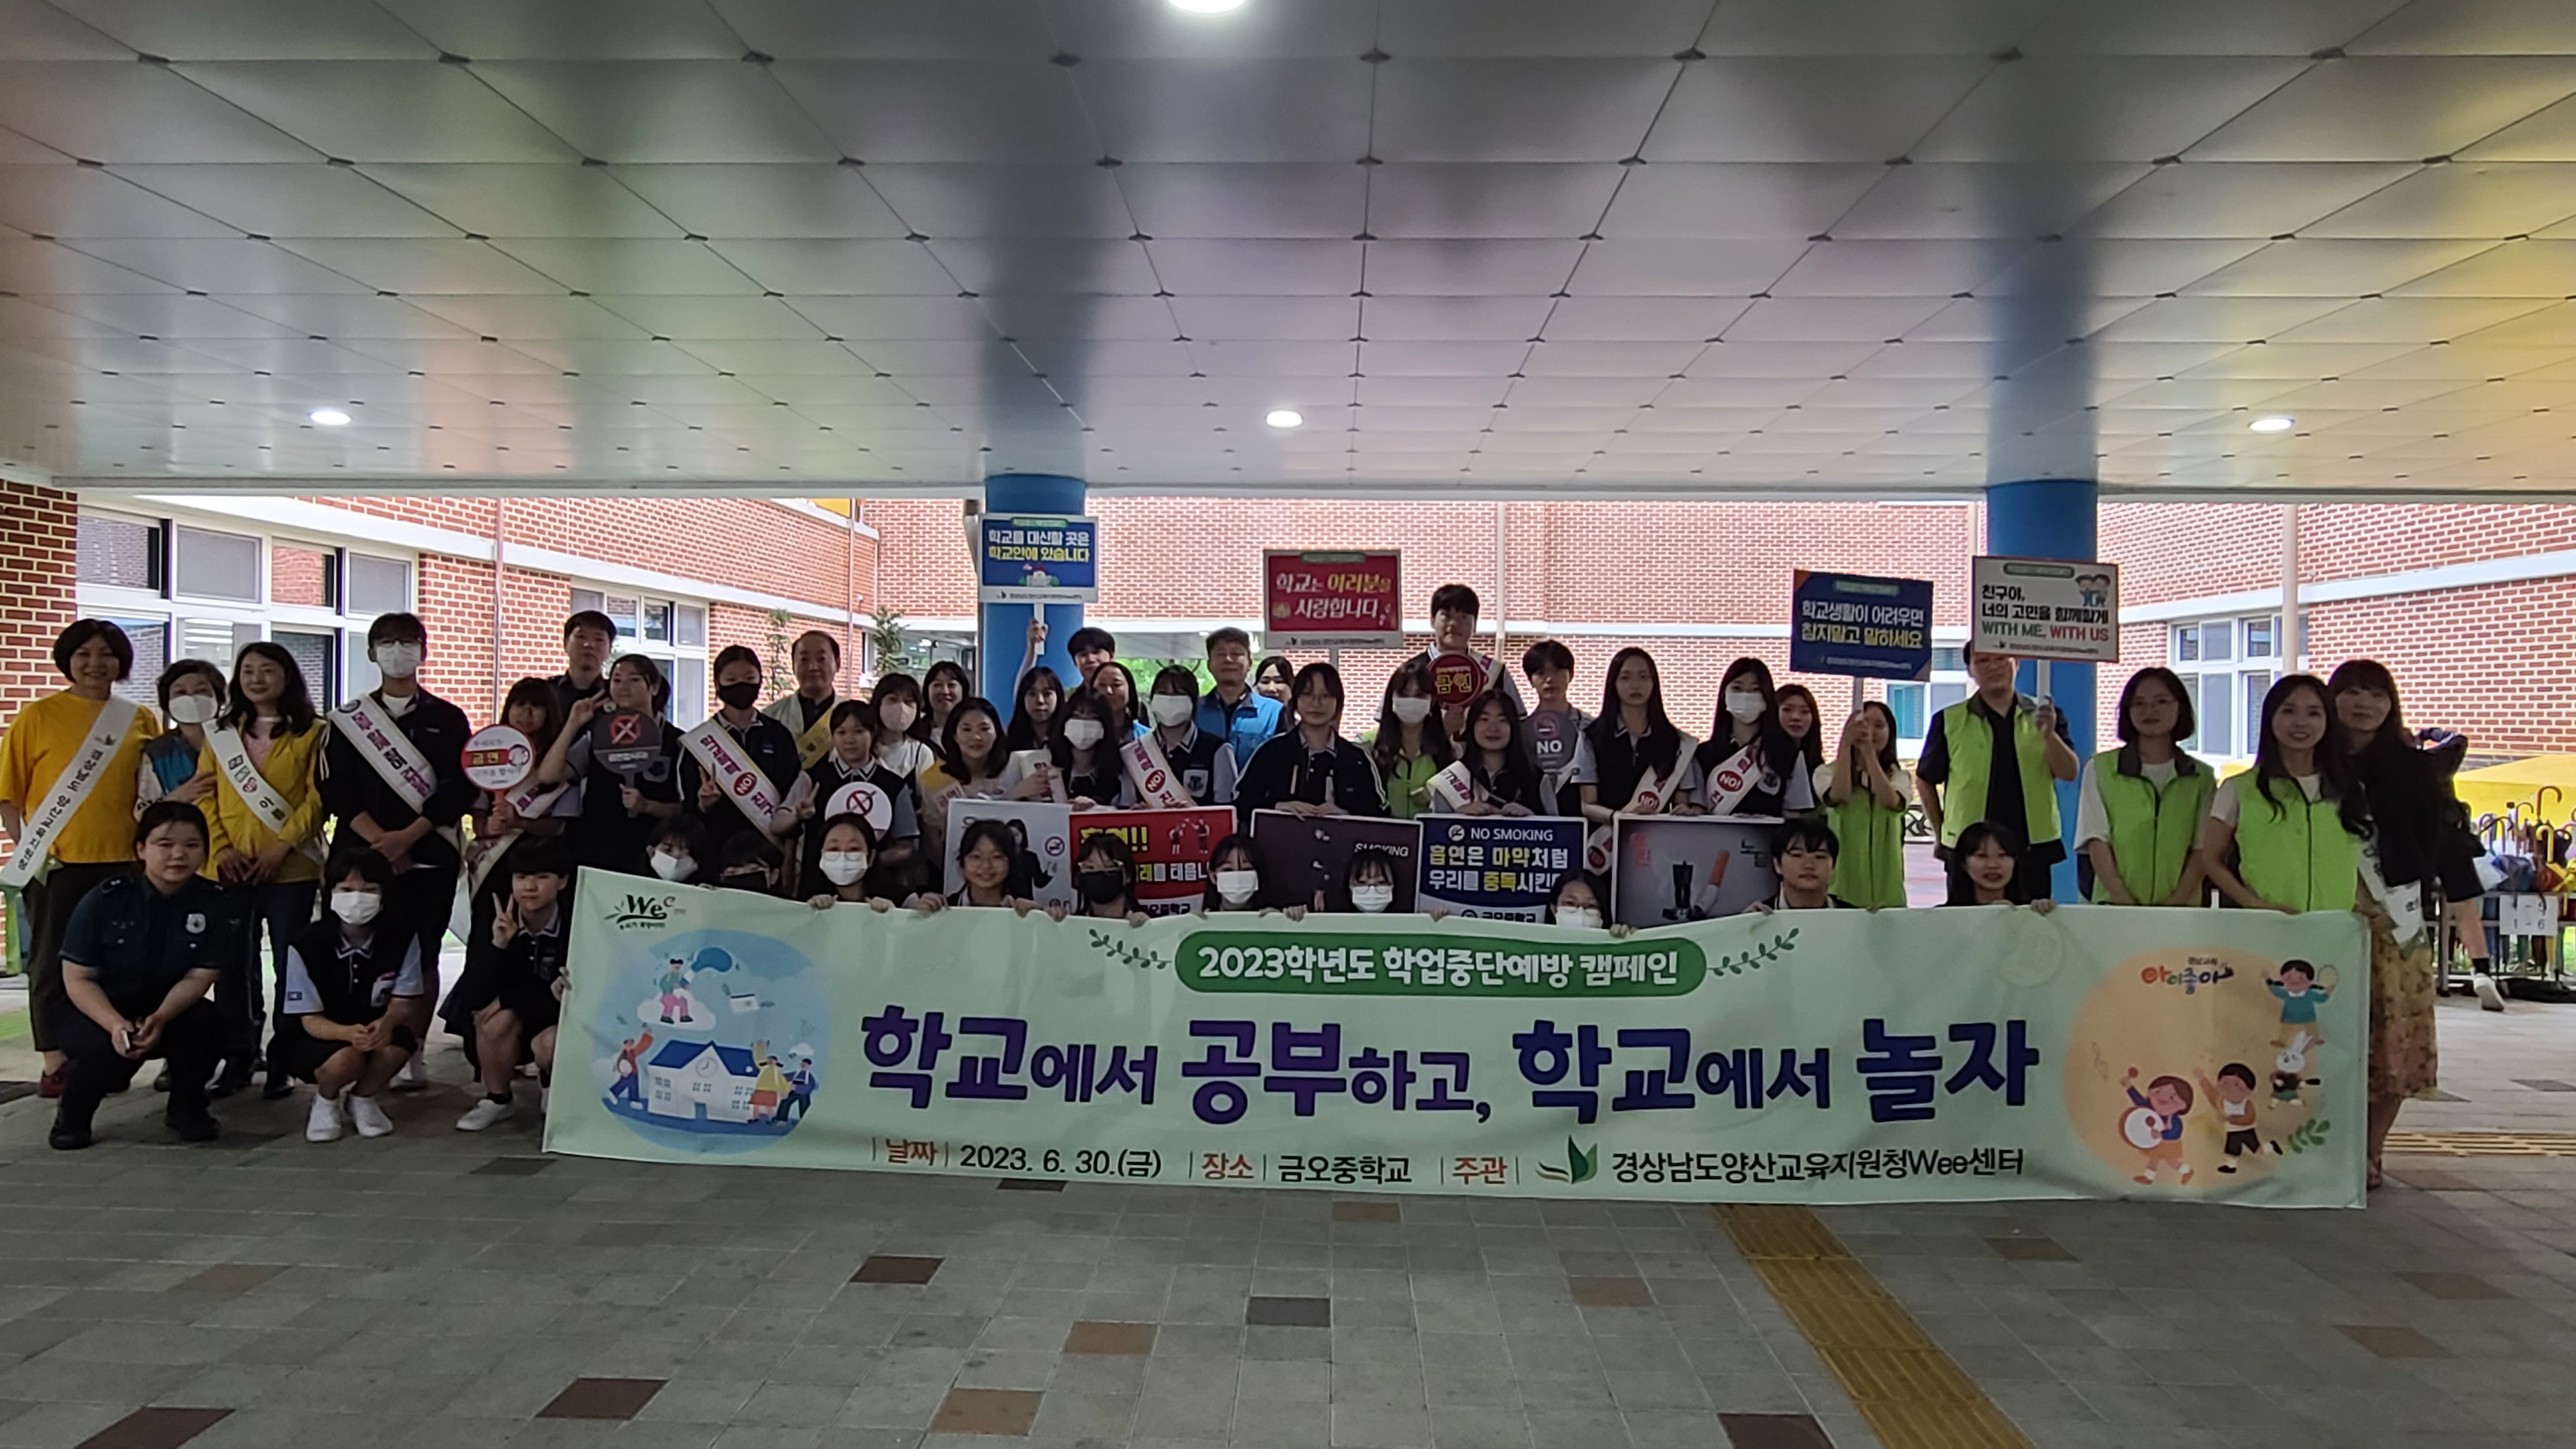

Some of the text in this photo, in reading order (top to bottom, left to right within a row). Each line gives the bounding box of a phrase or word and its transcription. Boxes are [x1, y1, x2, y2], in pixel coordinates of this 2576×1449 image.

[988, 530, 1089, 546] 학교를 대신할 곳은
[1041, 548, 1089, 562] 있습니다
[1276, 572, 1324, 594] 학교는
[1982, 584, 2025, 602] 친구야,
[1294, 597, 1379, 619] 사랑합니다
[1802, 599, 1924, 627] 학교생활이 어려우면
[1982, 602, 2108, 624] 너의 고민을 함께할게
[1802, 622, 1922, 648] 참지말고 말하세요
[1982, 620, 2018, 636] WITH
[2050, 625, 2085, 640] WITH
[2090, 627, 2109, 642] US
[1537, 740, 1562, 754] NO
[737, 774, 756, 794] NO!
[1147, 771, 1164, 790] NO!
[1720, 774, 1741, 790] NO!
[1471, 827, 1554, 842] NO SMOKING
[1429, 845, 1484, 866] 흡연은
[1492, 847, 1568, 869] 마약처럼
[1429, 870, 1478, 891] 우리를
[1198, 946, 1678, 988] 2023학년도 학업중단예방 캠페인
[860, 1006, 2041, 1125] 학교에서 공부하고, 학교에서 놀자
[885, 1138, 2025, 1184] 날짜 2023. 6. 30.(금) 장소 금오중학교 주관 경상남도양산교육지원청Wee센터
